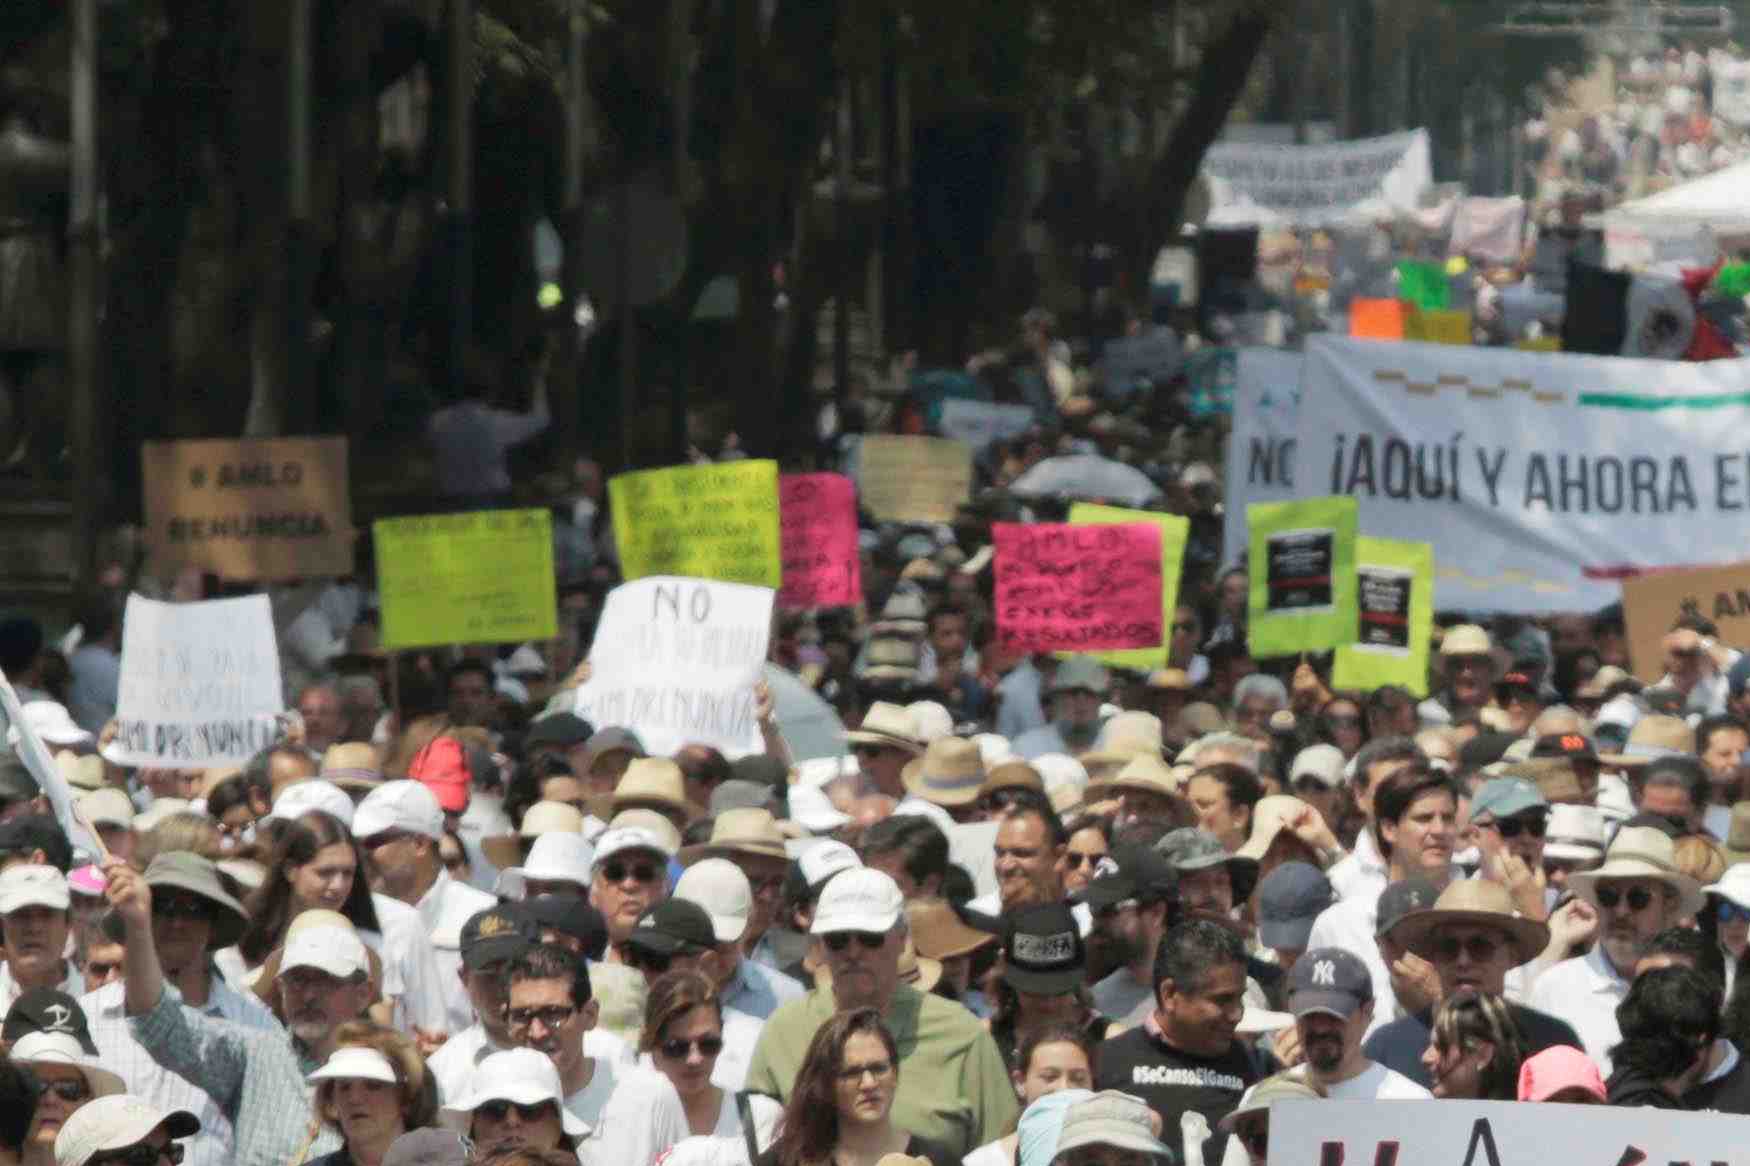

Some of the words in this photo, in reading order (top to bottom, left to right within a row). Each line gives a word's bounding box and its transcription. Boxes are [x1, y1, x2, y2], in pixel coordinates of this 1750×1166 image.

[1331, 431, 1465, 503] ¡AQUÍ
[1474, 445, 1510, 508] Y
[1523, 453, 1698, 514] AHORA
[651, 582, 714, 624] NO
